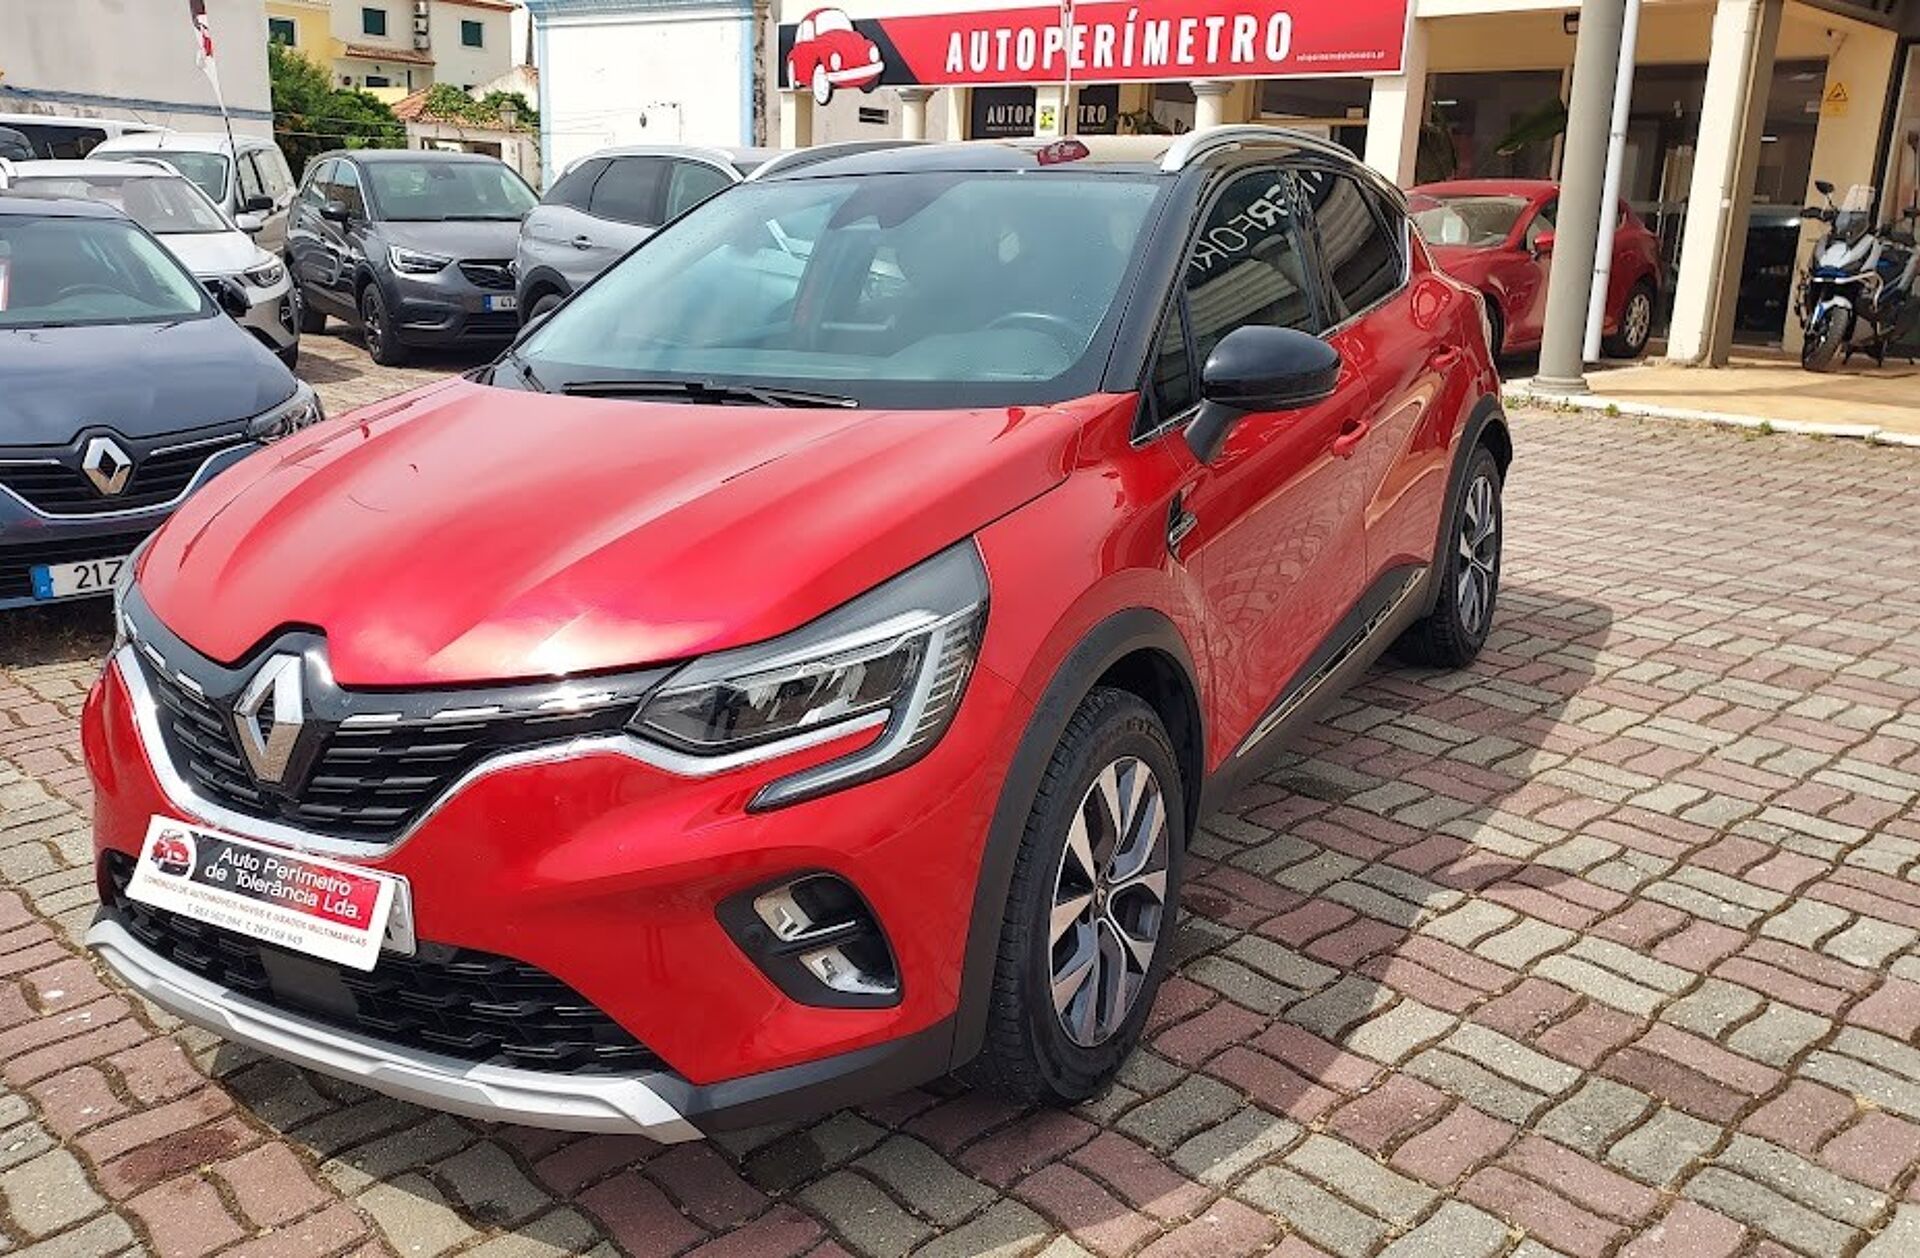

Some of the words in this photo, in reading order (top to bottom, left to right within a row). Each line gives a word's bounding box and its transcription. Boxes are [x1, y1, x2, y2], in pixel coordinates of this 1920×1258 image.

[945, 8, 1293, 73] AUTOPERÍMETRO
[205, 862, 228, 881] de
[235, 868, 318, 908] Tolerância
[322, 893, 361, 920] Lda.
[219, 847, 259, 872] Auto
[263, 857, 351, 896] Perímetro
